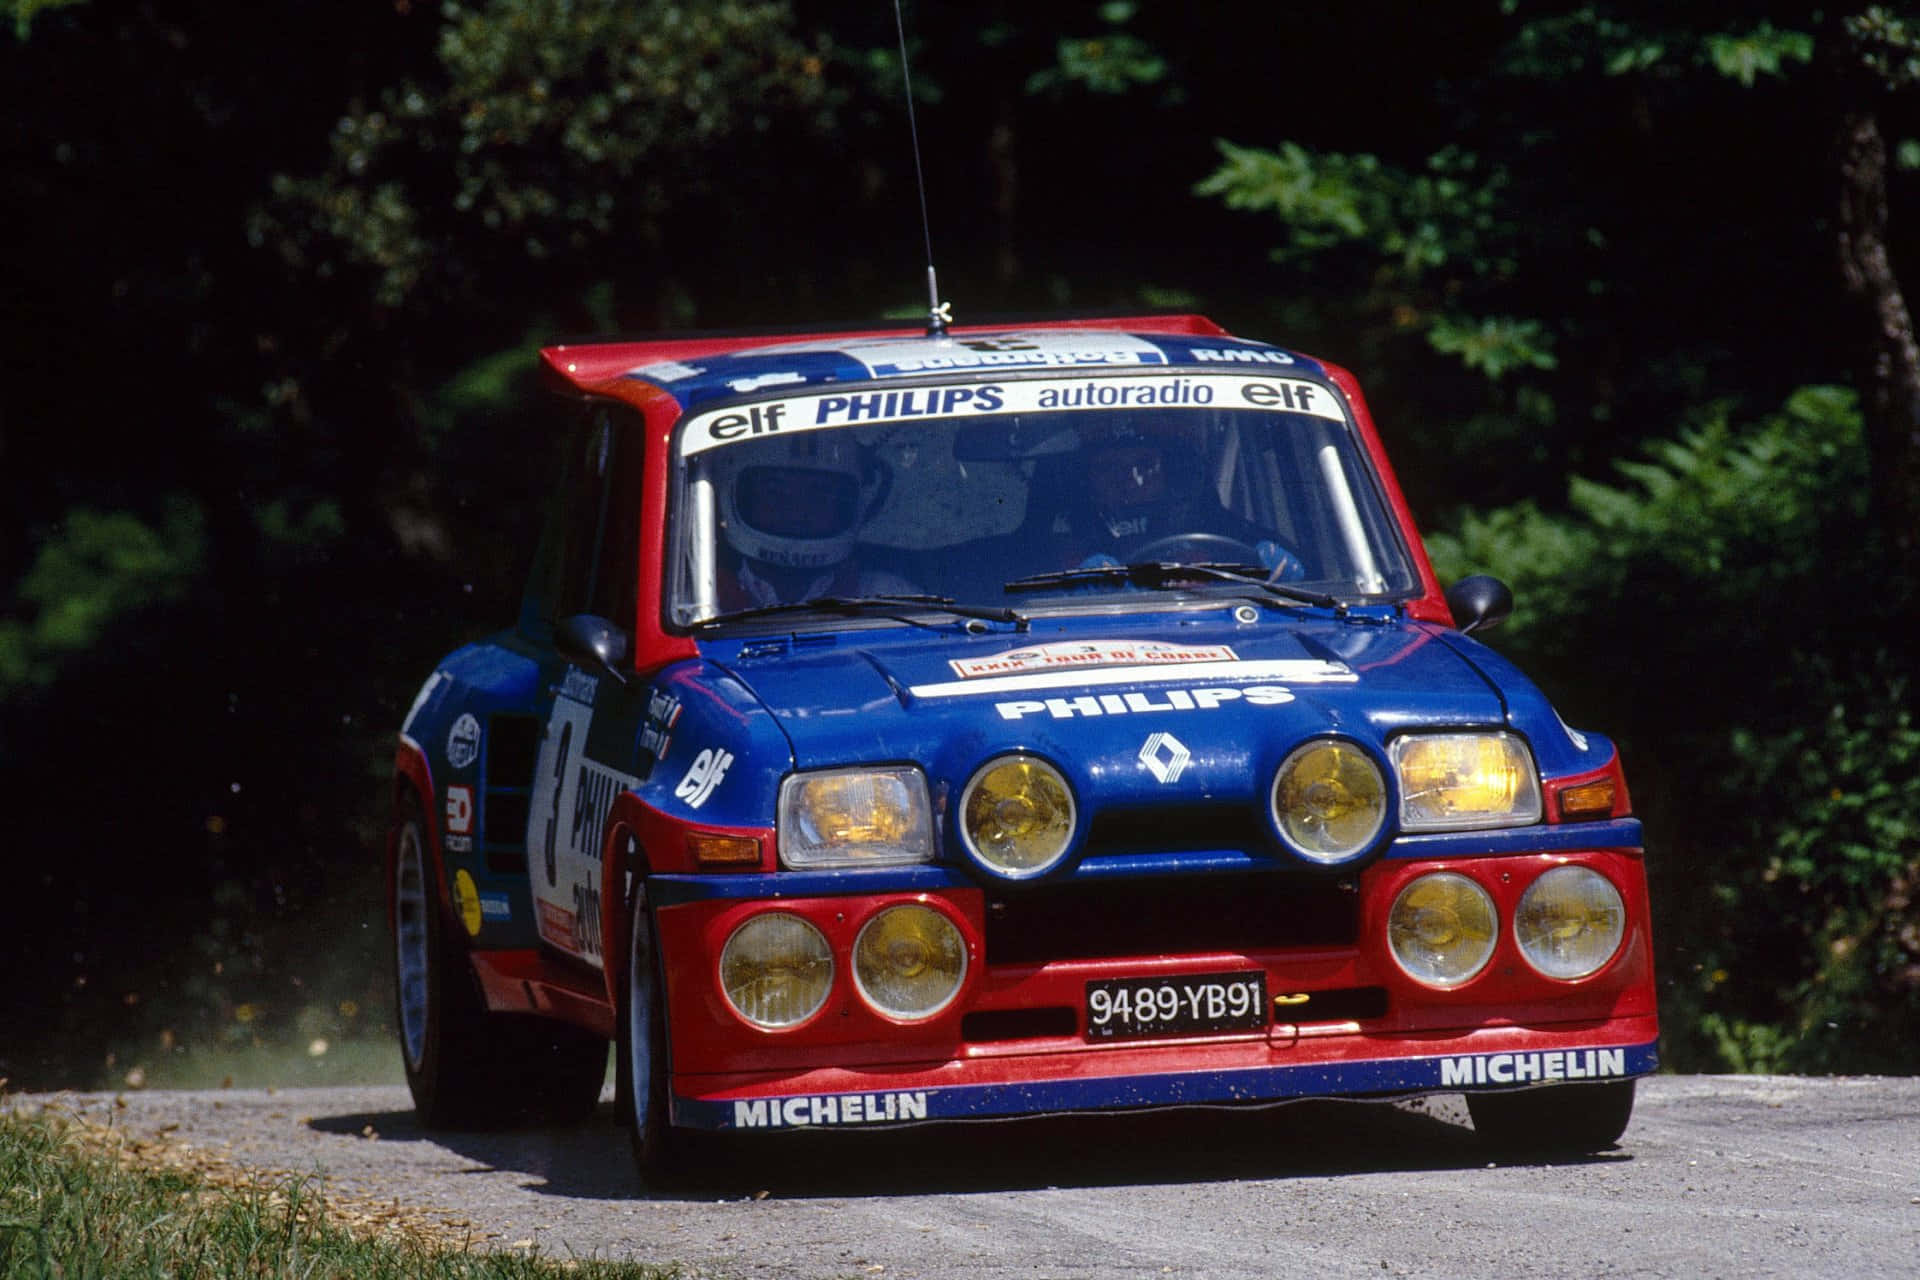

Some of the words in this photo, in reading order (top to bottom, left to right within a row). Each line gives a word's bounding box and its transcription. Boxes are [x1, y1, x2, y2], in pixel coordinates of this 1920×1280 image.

[709, 404, 786, 439] elf
[816, 386, 1005, 424] PHILIPS
[1038, 380, 1214, 408] autoradio
[1241, 383, 1316, 410] elf
[995, 686, 1295, 719] PHILIPS
[674, 747, 735, 809] elf
[1090, 981, 1261, 1024] 9489-YB91
[1439, 1048, 1625, 1086] MICHELIN
[734, 1092, 927, 1128] MICHELIN
